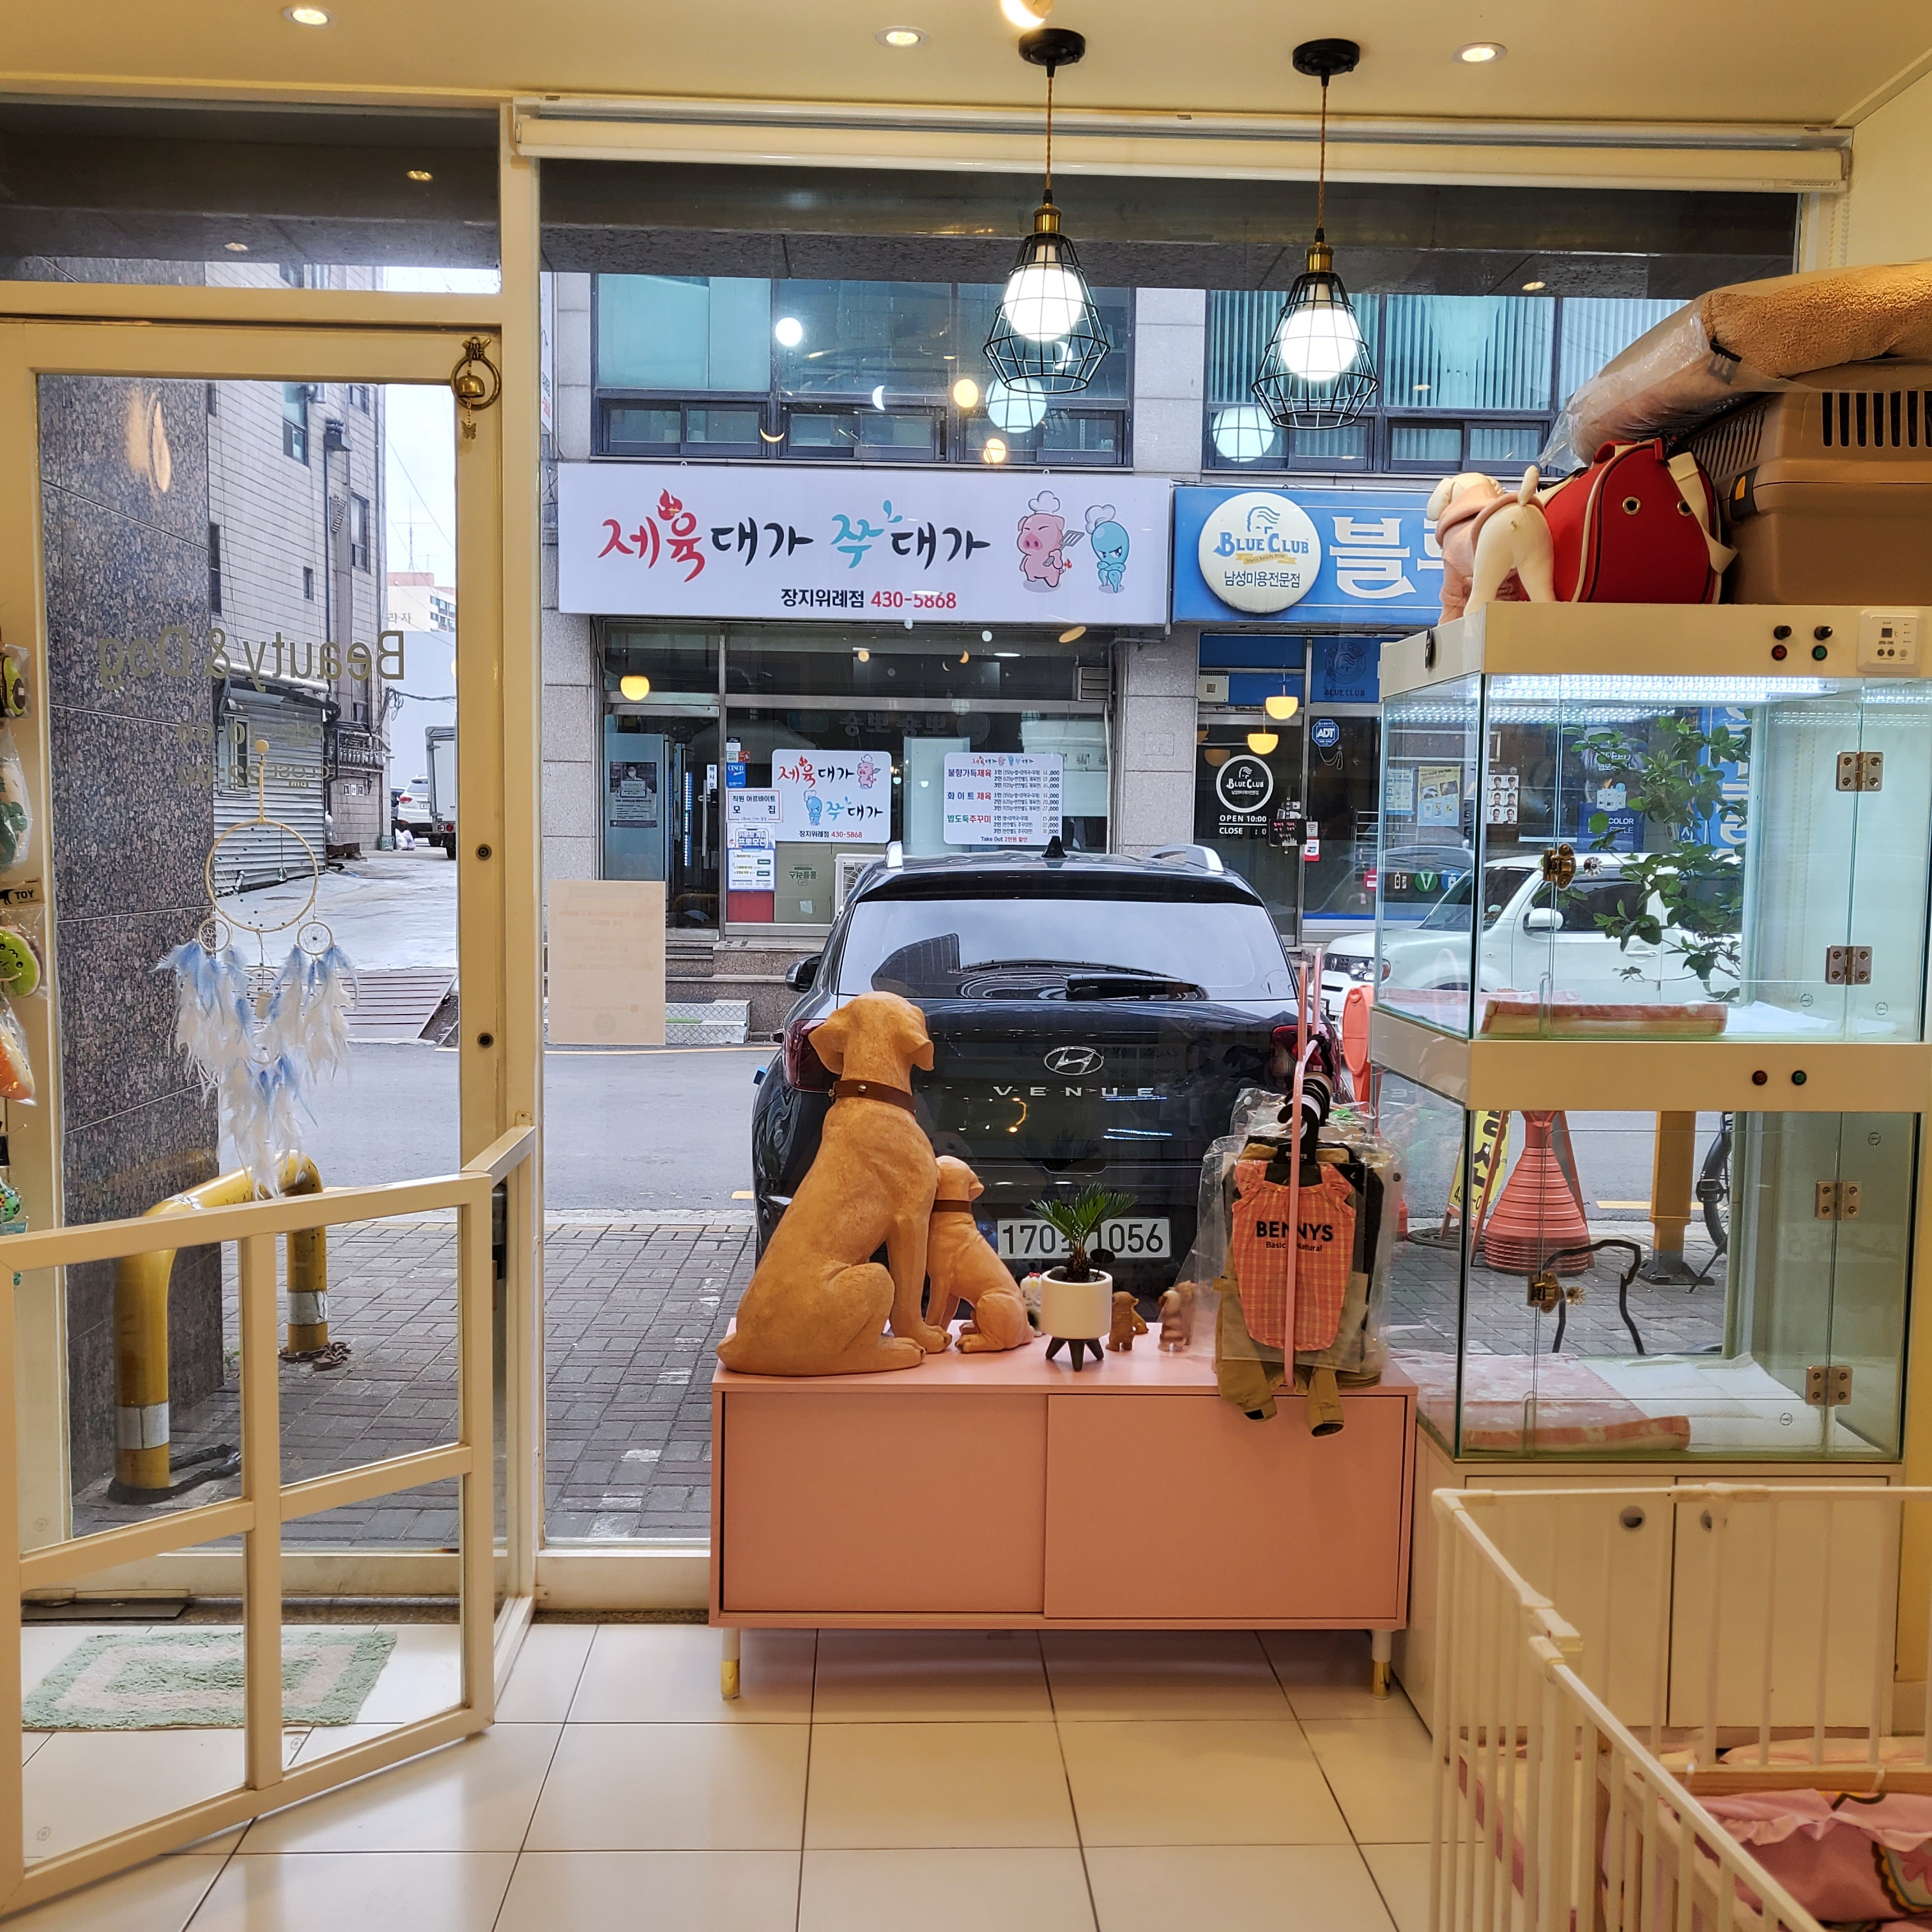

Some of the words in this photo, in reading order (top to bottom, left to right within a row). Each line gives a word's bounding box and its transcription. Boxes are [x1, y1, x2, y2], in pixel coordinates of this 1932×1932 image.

[598, 509, 813, 583] 제육대가
[1213, 532, 1265, 557] BLUE
[1267, 533, 1309, 554] CLUB
[1224, 571, 1300, 588] 남성미용전문점
[781, 588, 864, 608] 장지위례점
[871, 591, 957, 609] 430-5868
[1317, 728, 1335, 738] ADT
[777, 763, 855, 789] 제육대가
[1226, 778, 1246, 790] BLUE
[1246, 779, 1264, 789] CLUB
[733, 806, 741, 814] 모
[768, 805, 776, 814] 집
[799, 830, 829, 838] 장지위례점
[831, 831, 862, 839] 430-5868
[14, 889, 34, 900] TOY
[993, 1086, 1154, 1097] VENUE
[1285, 1151, 1308, 1160] BEYS
[1266, 1241, 1286, 1249] Basic
